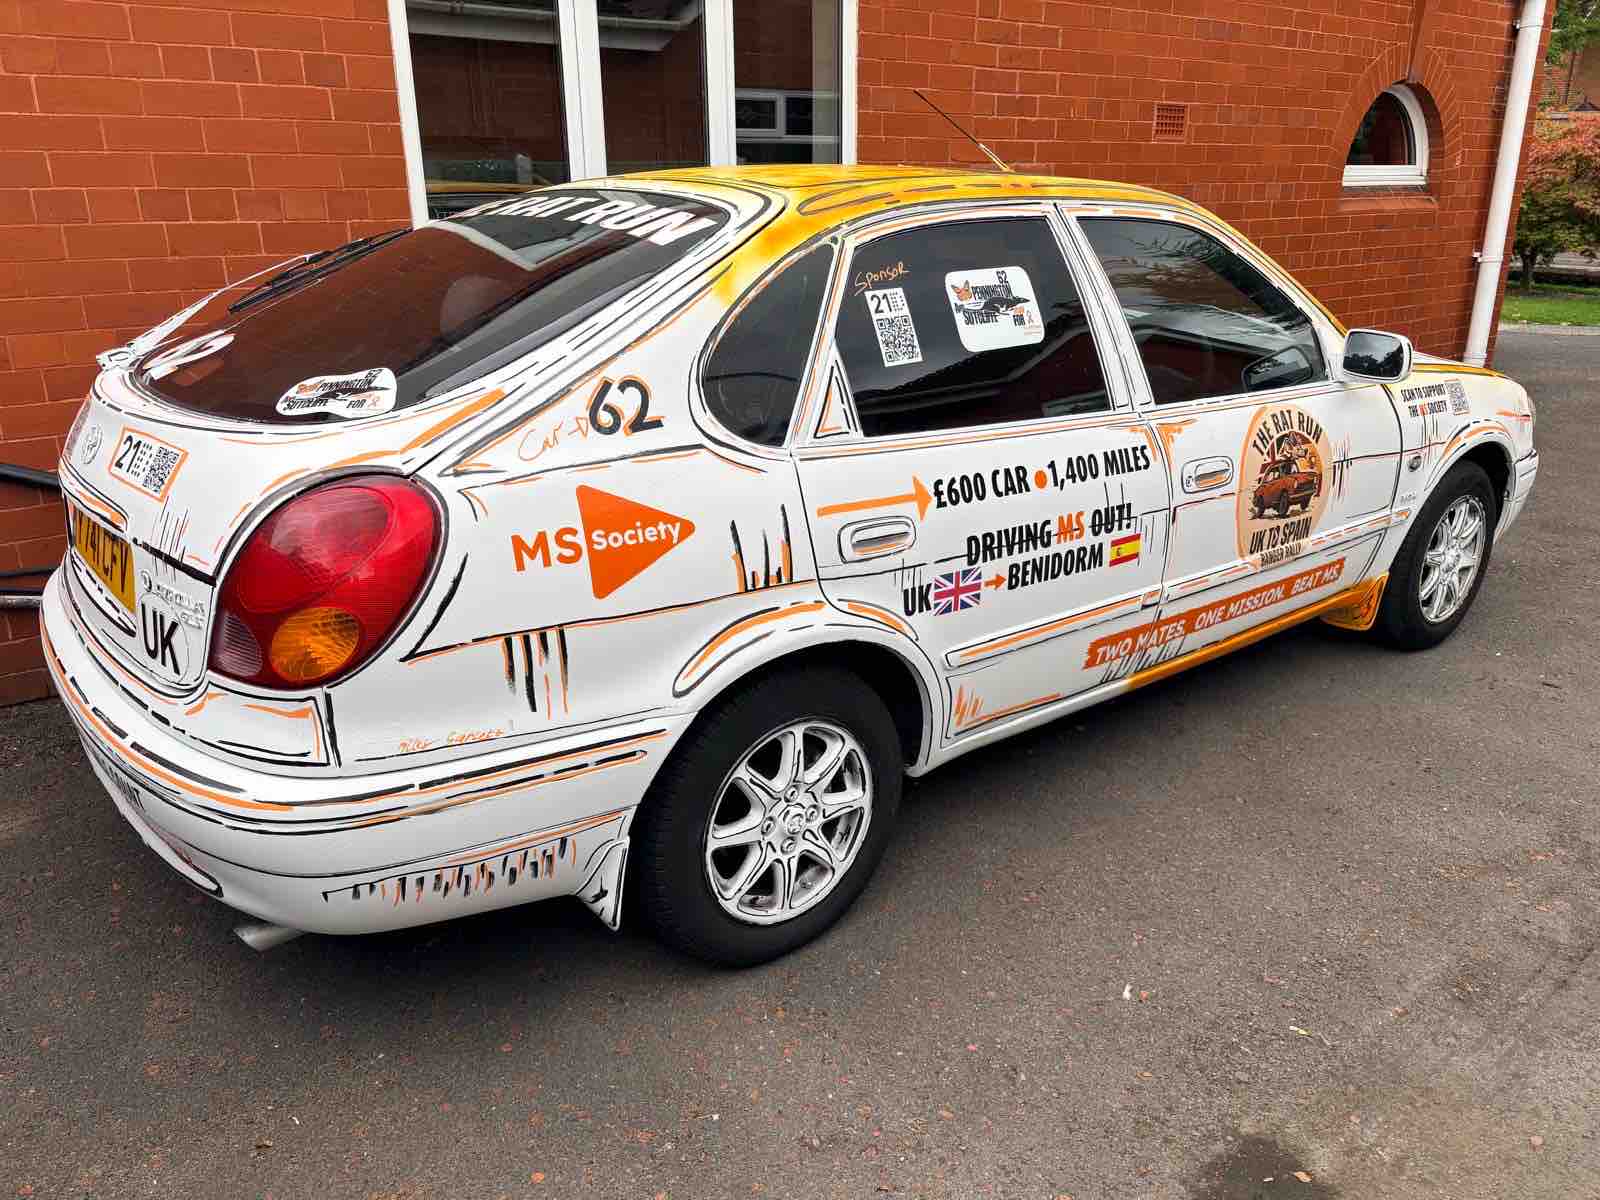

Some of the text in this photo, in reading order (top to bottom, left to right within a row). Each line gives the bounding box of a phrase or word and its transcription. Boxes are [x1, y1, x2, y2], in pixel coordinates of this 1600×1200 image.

[564, 200, 718, 246] RUN
[971, 284, 1013, 301] PENNINGTON
[996, 270, 1009, 284] 62
[870, 294, 892, 313] 21
[1013, 314, 1025, 327] FOR
[346, 399, 367, 409] FOR
[588, 376, 665, 435] 62
[1400, 384, 1447, 402] SCAN TO SUPPORT
[1408, 404, 1419, 417] THE
[1427, 400, 1448, 414] SOCIETY
[114, 435, 142, 472] 21
[1252, 409, 1322, 456] THE RAT RUN
[933, 445, 1151, 508] £600 CAR 1,400 MILES
[511, 521, 681, 572] MS Society
[966, 503, 1132, 566] DRIVING MS OUT!
[1250, 516, 1313, 555] UK TO SPAIN
[902, 543, 1104, 617] UK BENIDORM
[1096, 638, 1133, 665] TWO
[1193, 606, 1226, 632] ONE
[1291, 571, 1322, 596] BEAT
[141, 603, 181, 676] UK
